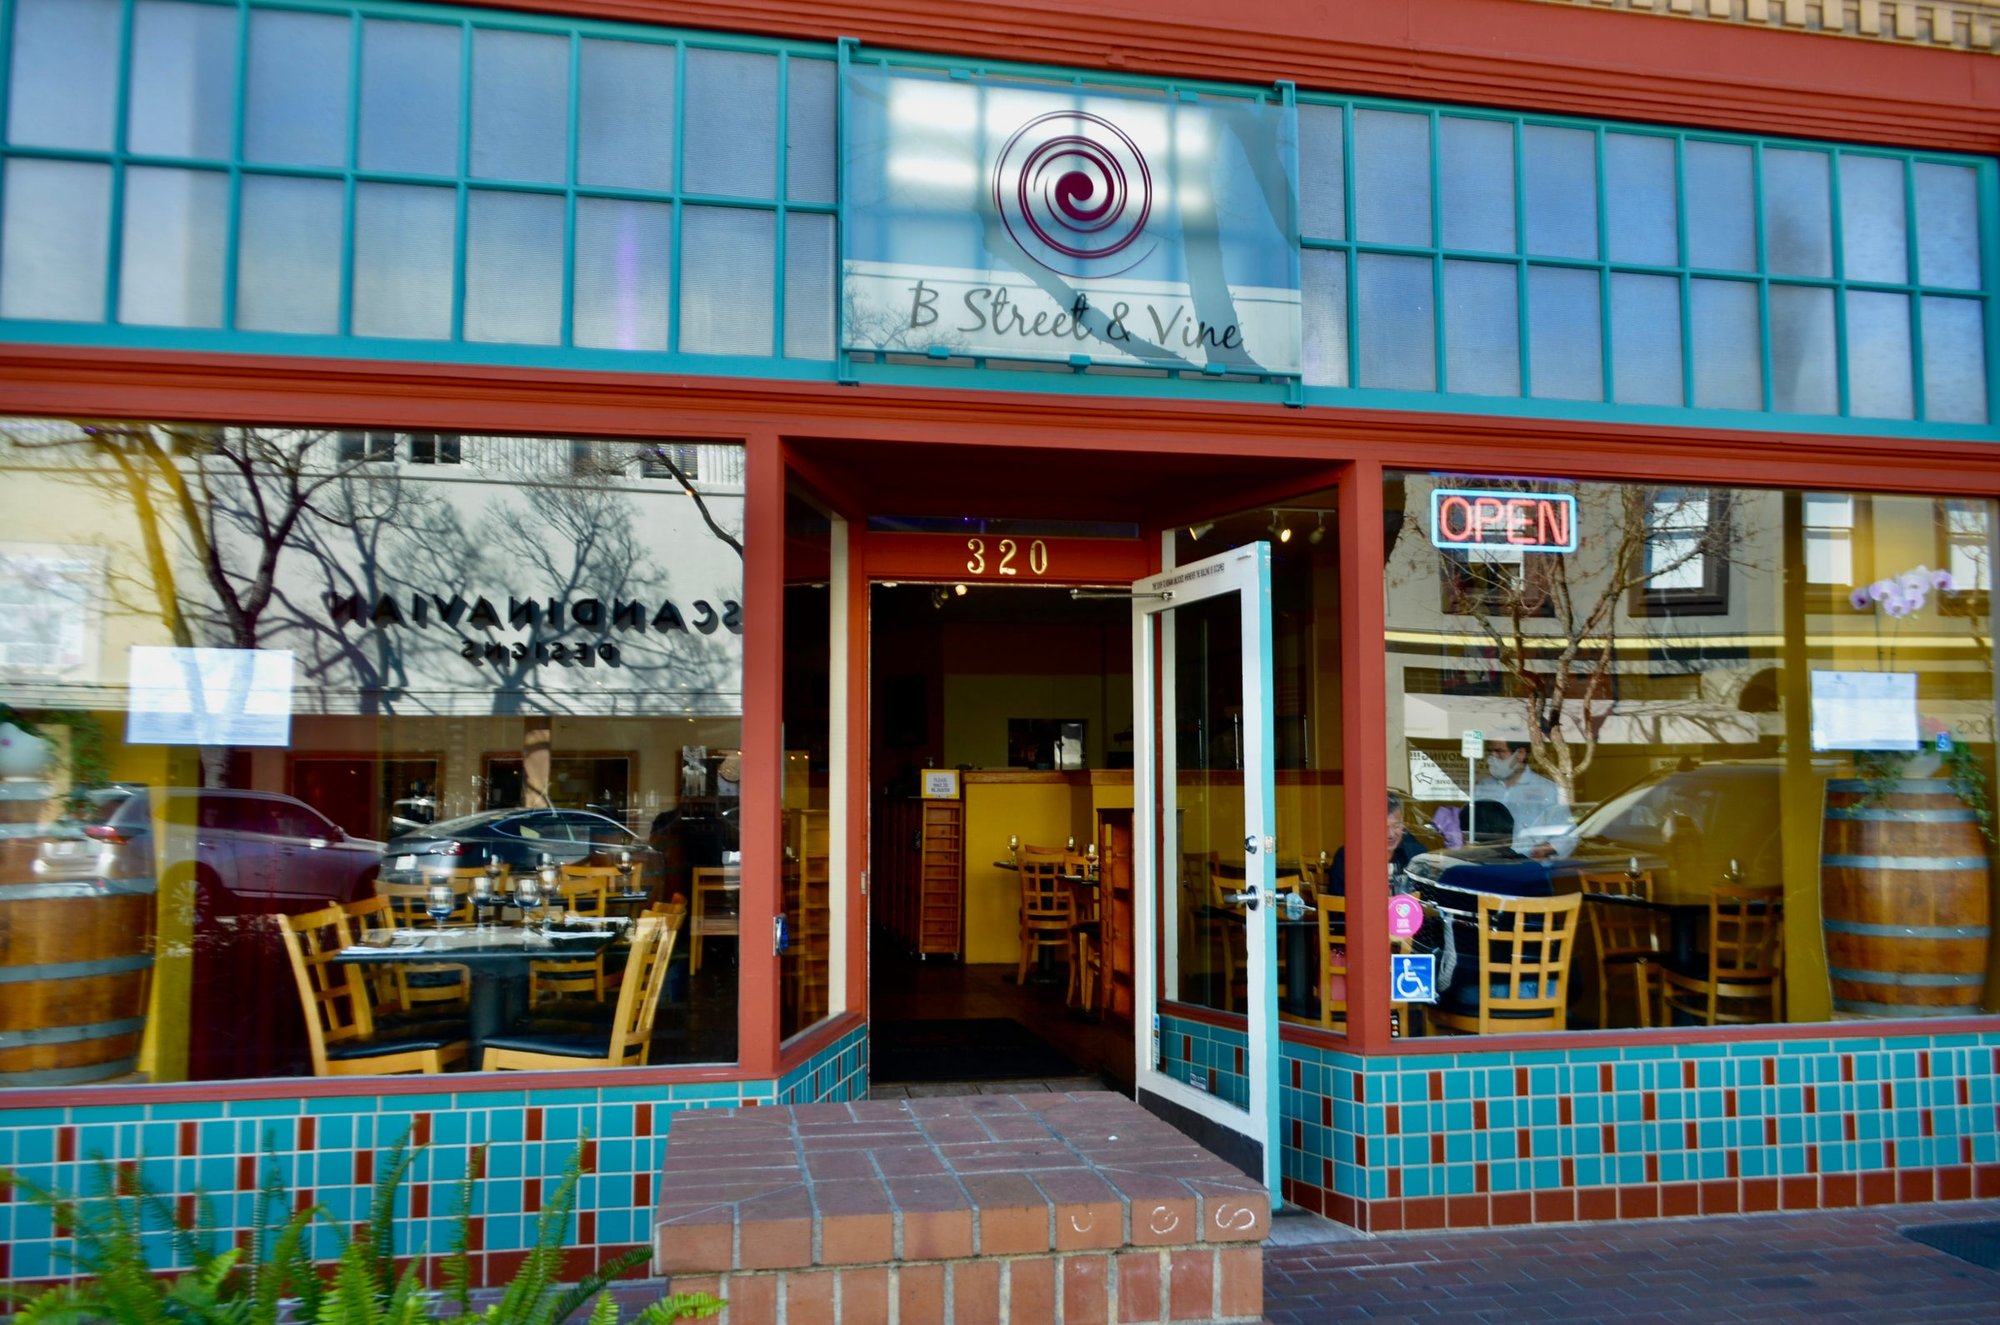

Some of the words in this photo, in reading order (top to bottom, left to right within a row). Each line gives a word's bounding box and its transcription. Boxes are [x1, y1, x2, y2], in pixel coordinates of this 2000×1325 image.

[908, 279, 940, 330] B
[956, 286, 1092, 342] Street
[1106, 301, 1132, 342] &
[1147, 304, 1244, 350] Vine
[1440, 496, 1569, 545] OPEN
[967, 538, 1047, 575] 320
